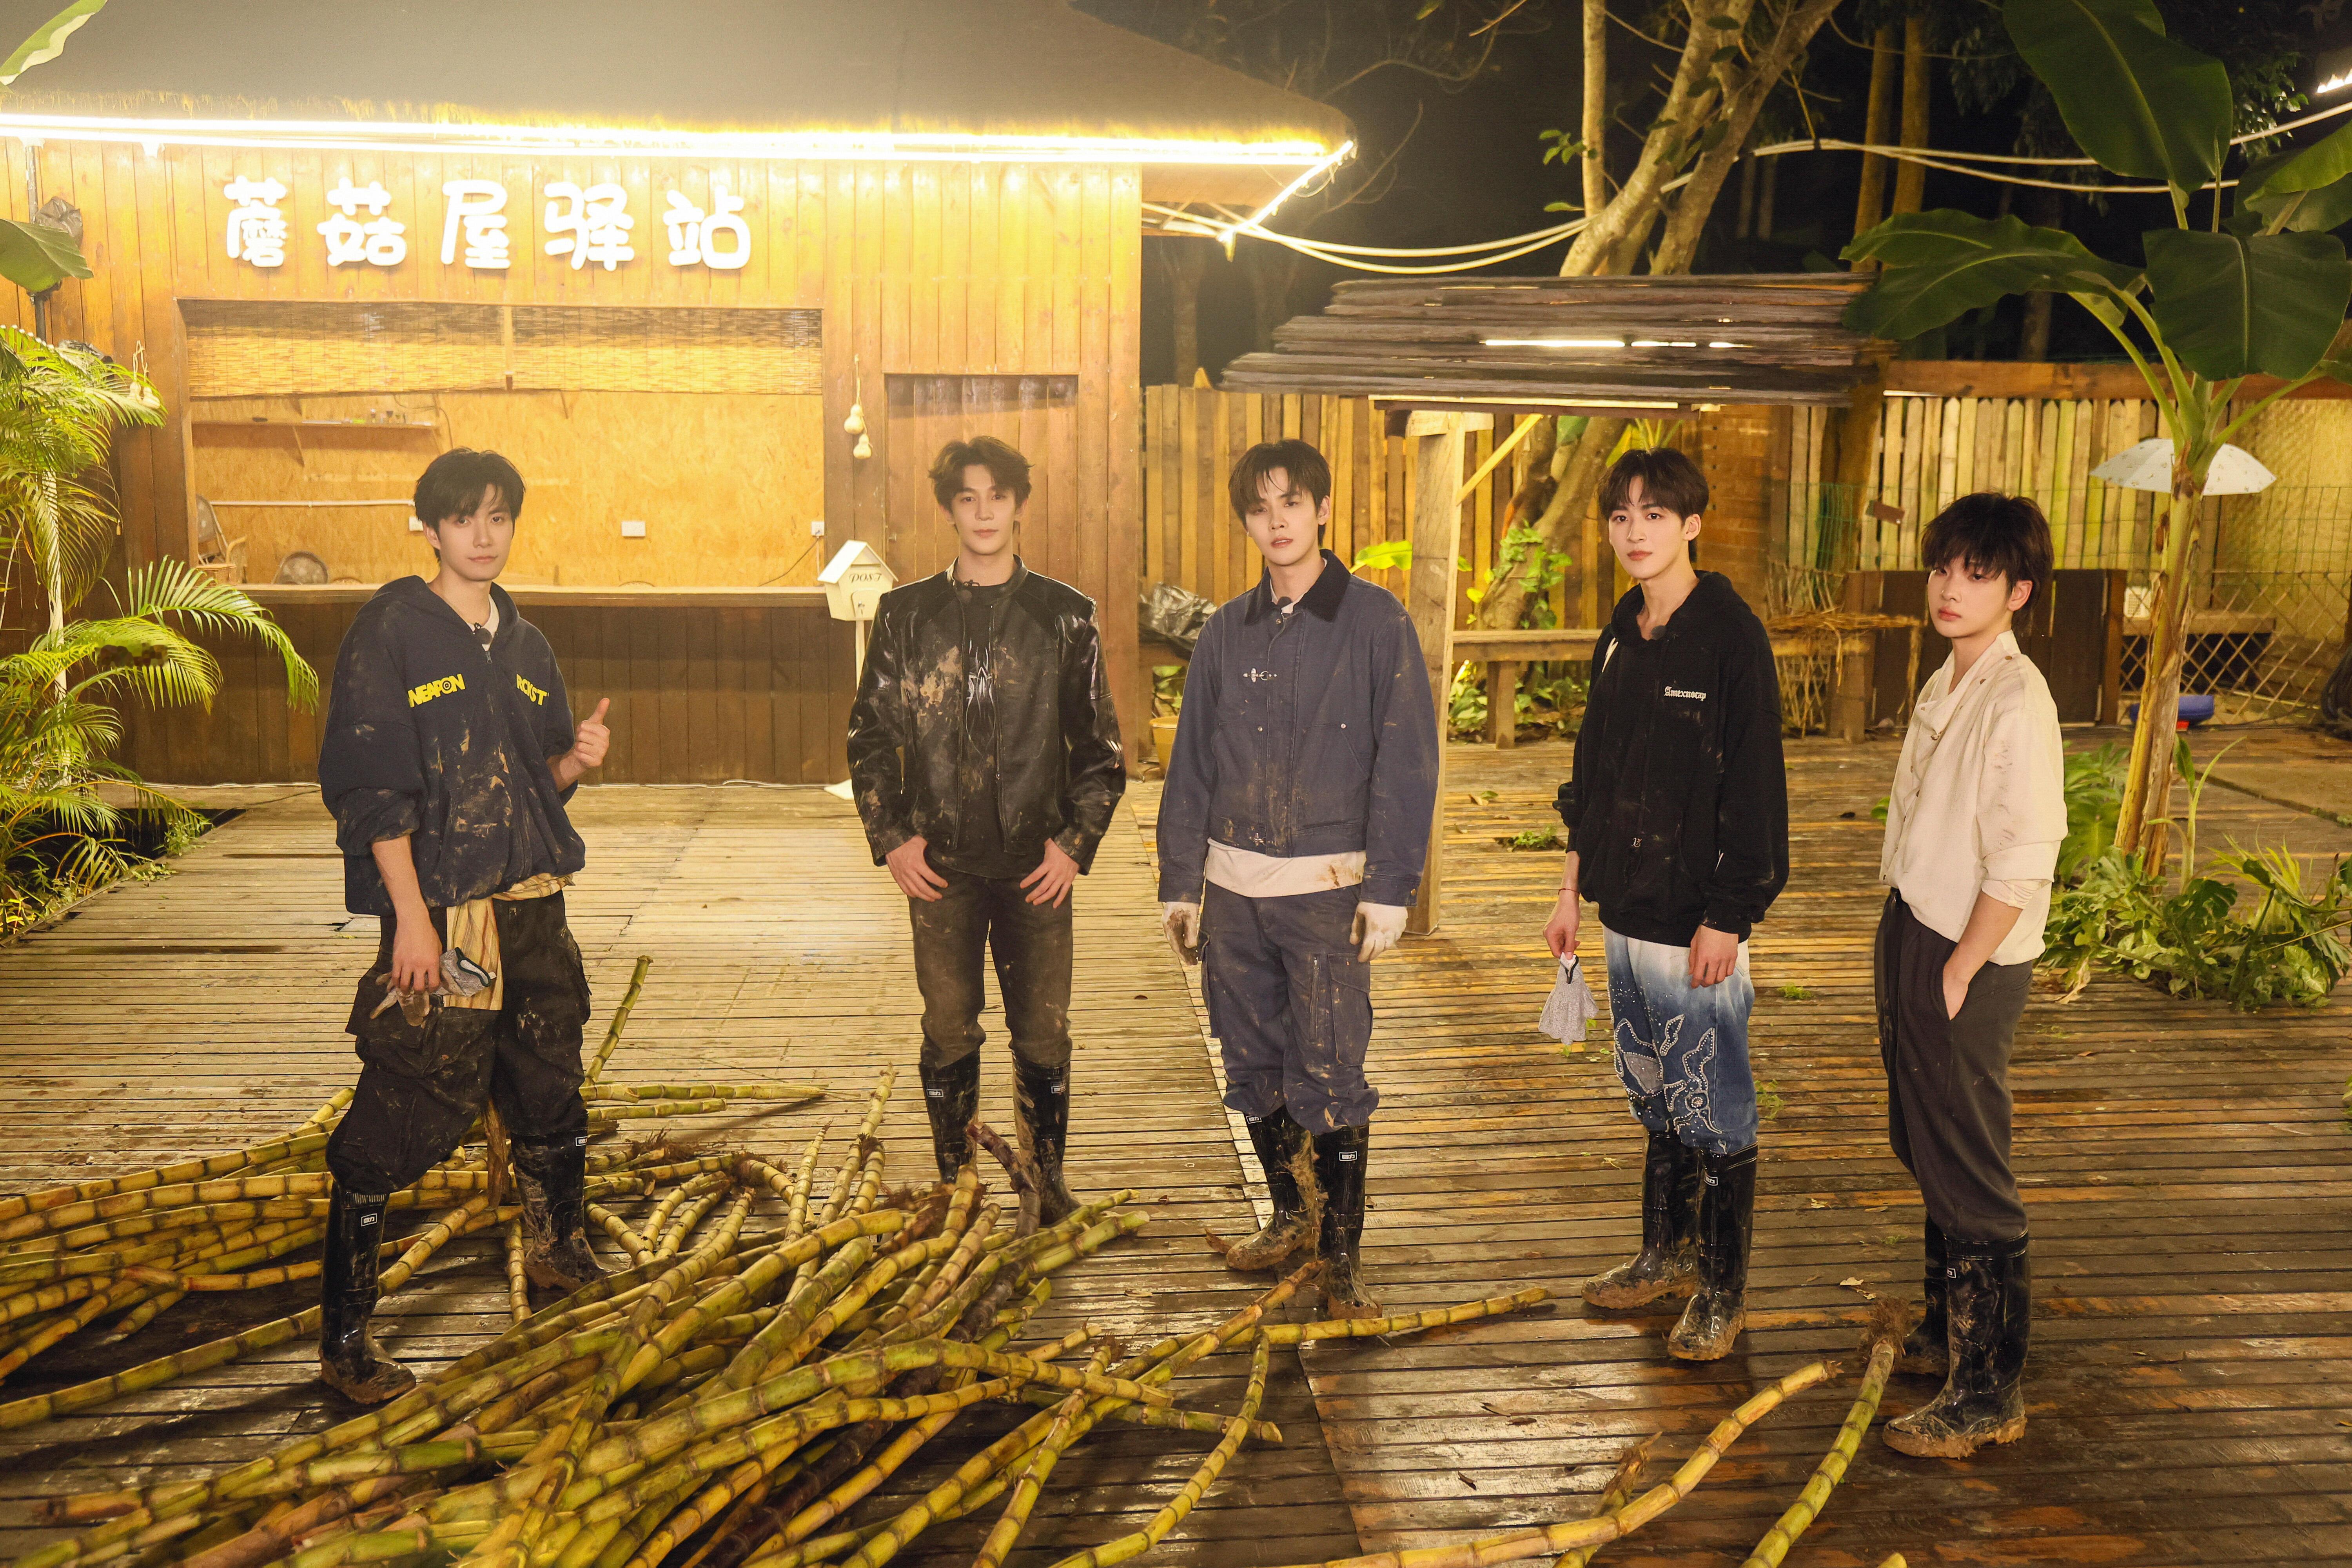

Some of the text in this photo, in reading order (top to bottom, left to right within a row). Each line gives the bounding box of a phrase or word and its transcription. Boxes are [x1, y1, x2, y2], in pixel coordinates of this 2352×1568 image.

[223, 175, 751, 271] 蘑菇屋驿站
[849, 573, 882, 583] POST
